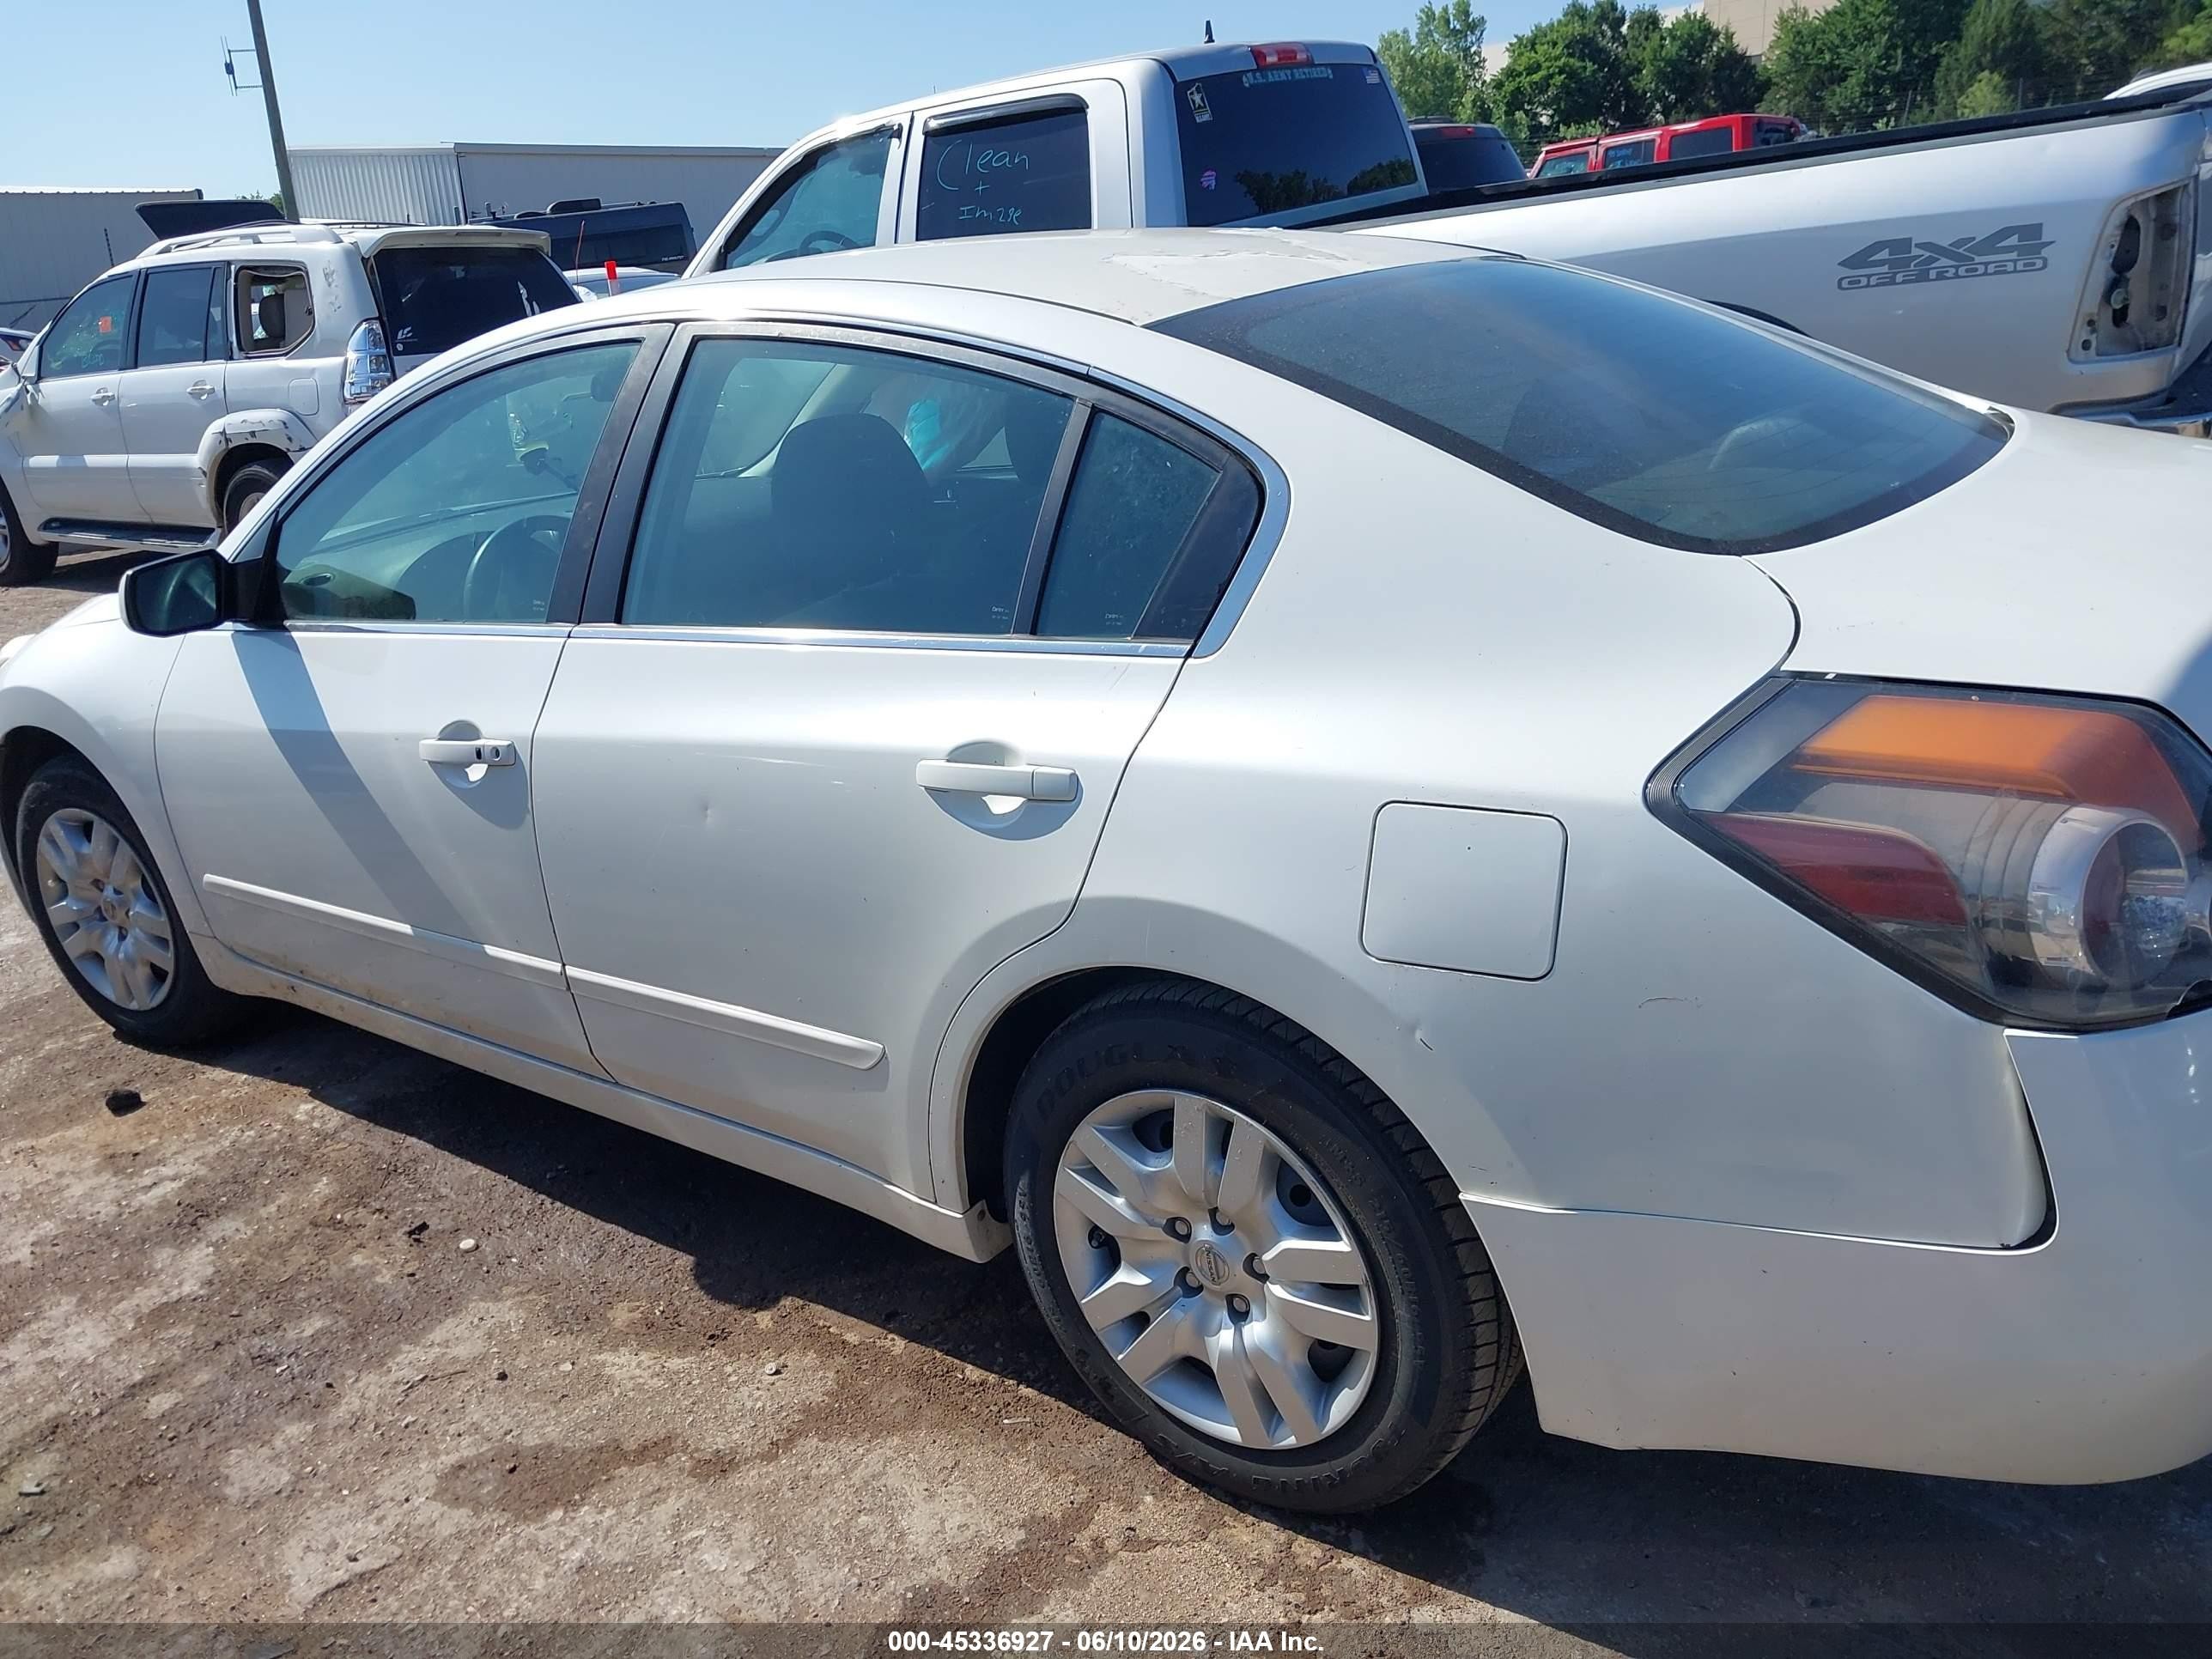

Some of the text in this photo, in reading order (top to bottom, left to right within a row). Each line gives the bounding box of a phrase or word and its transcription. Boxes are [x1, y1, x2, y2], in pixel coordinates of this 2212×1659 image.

[1267, 69, 1291, 82] ARMY
[936, 139, 1030, 191] Clean
[1836, 222, 2057, 271] 4x4
[1840, 258, 2043, 289] OFF ROAD
[1205, 1249, 1218, 1283] NISSAN
